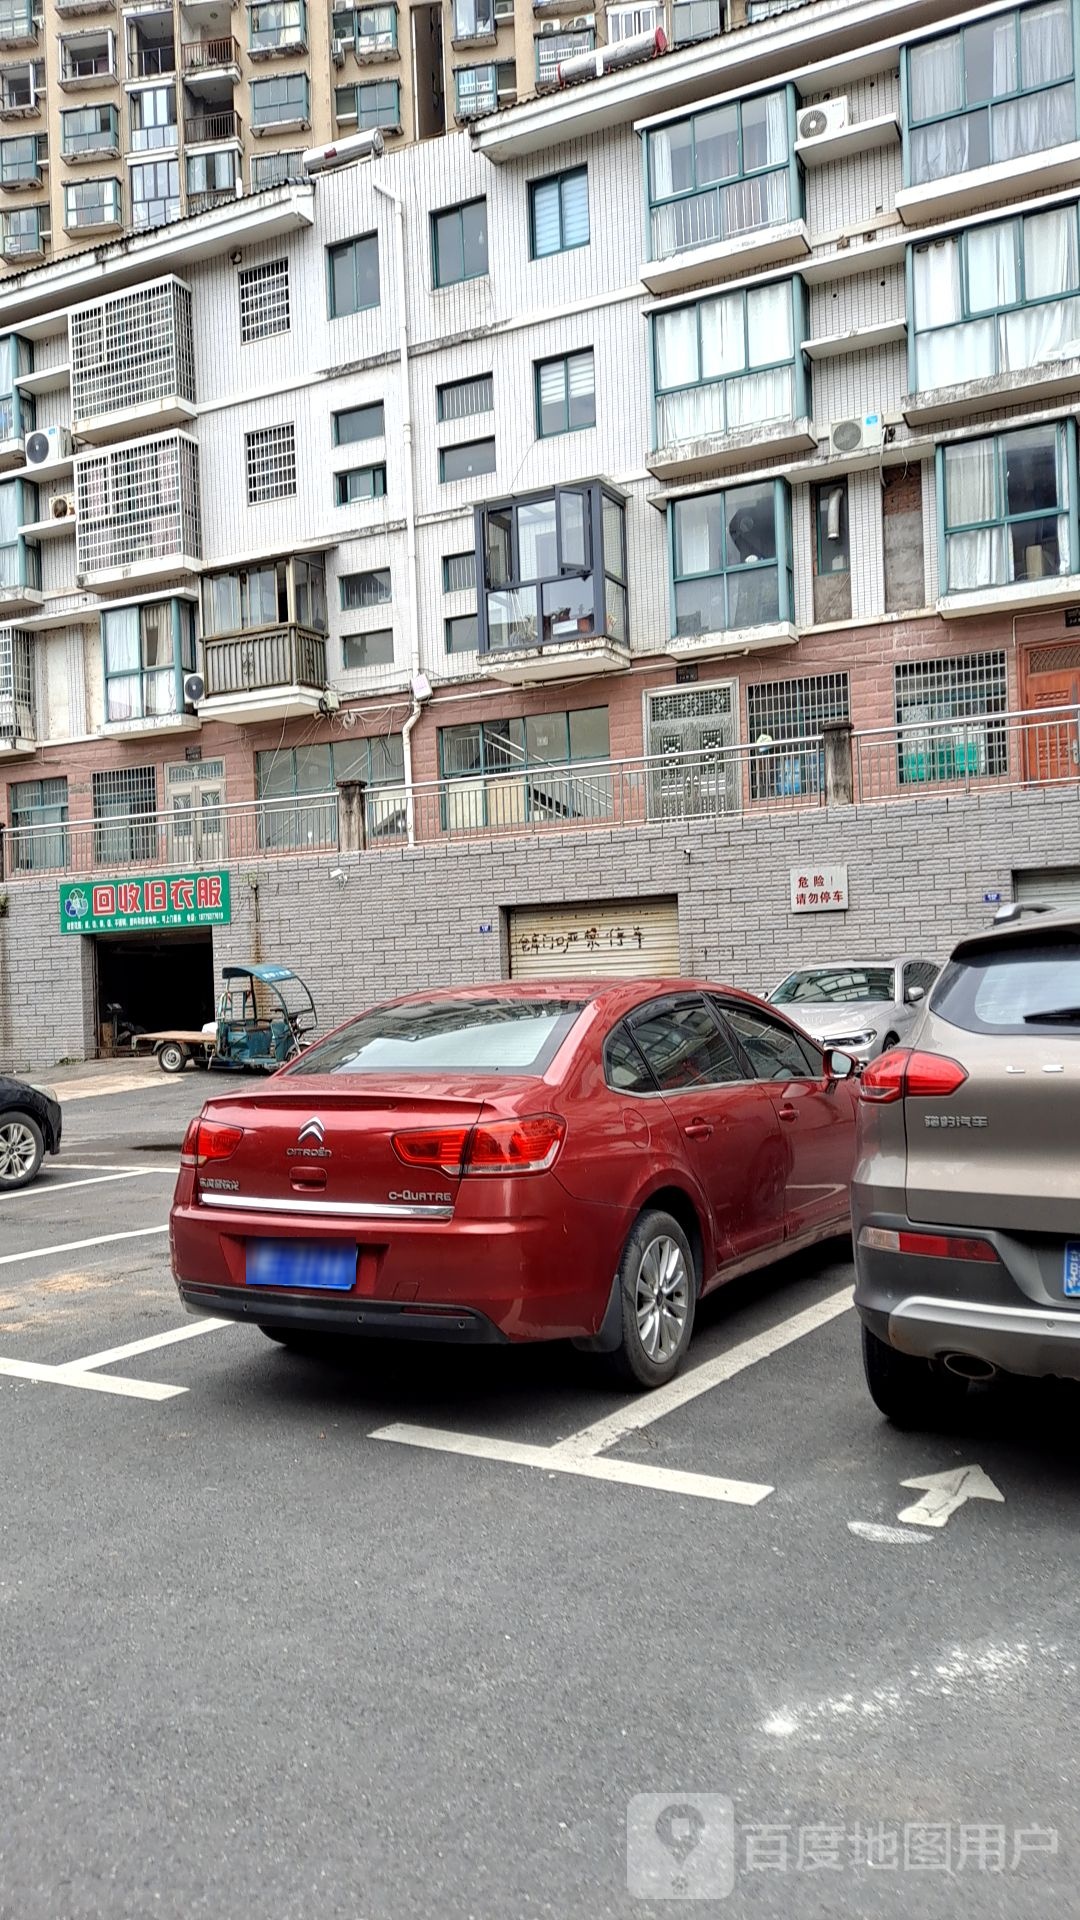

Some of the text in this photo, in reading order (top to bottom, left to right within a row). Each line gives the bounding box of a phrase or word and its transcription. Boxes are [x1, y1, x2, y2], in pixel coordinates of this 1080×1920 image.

[92, 876, 222, 915] 回收旧衣服
[796, 890, 844, 905] 请勿停车
